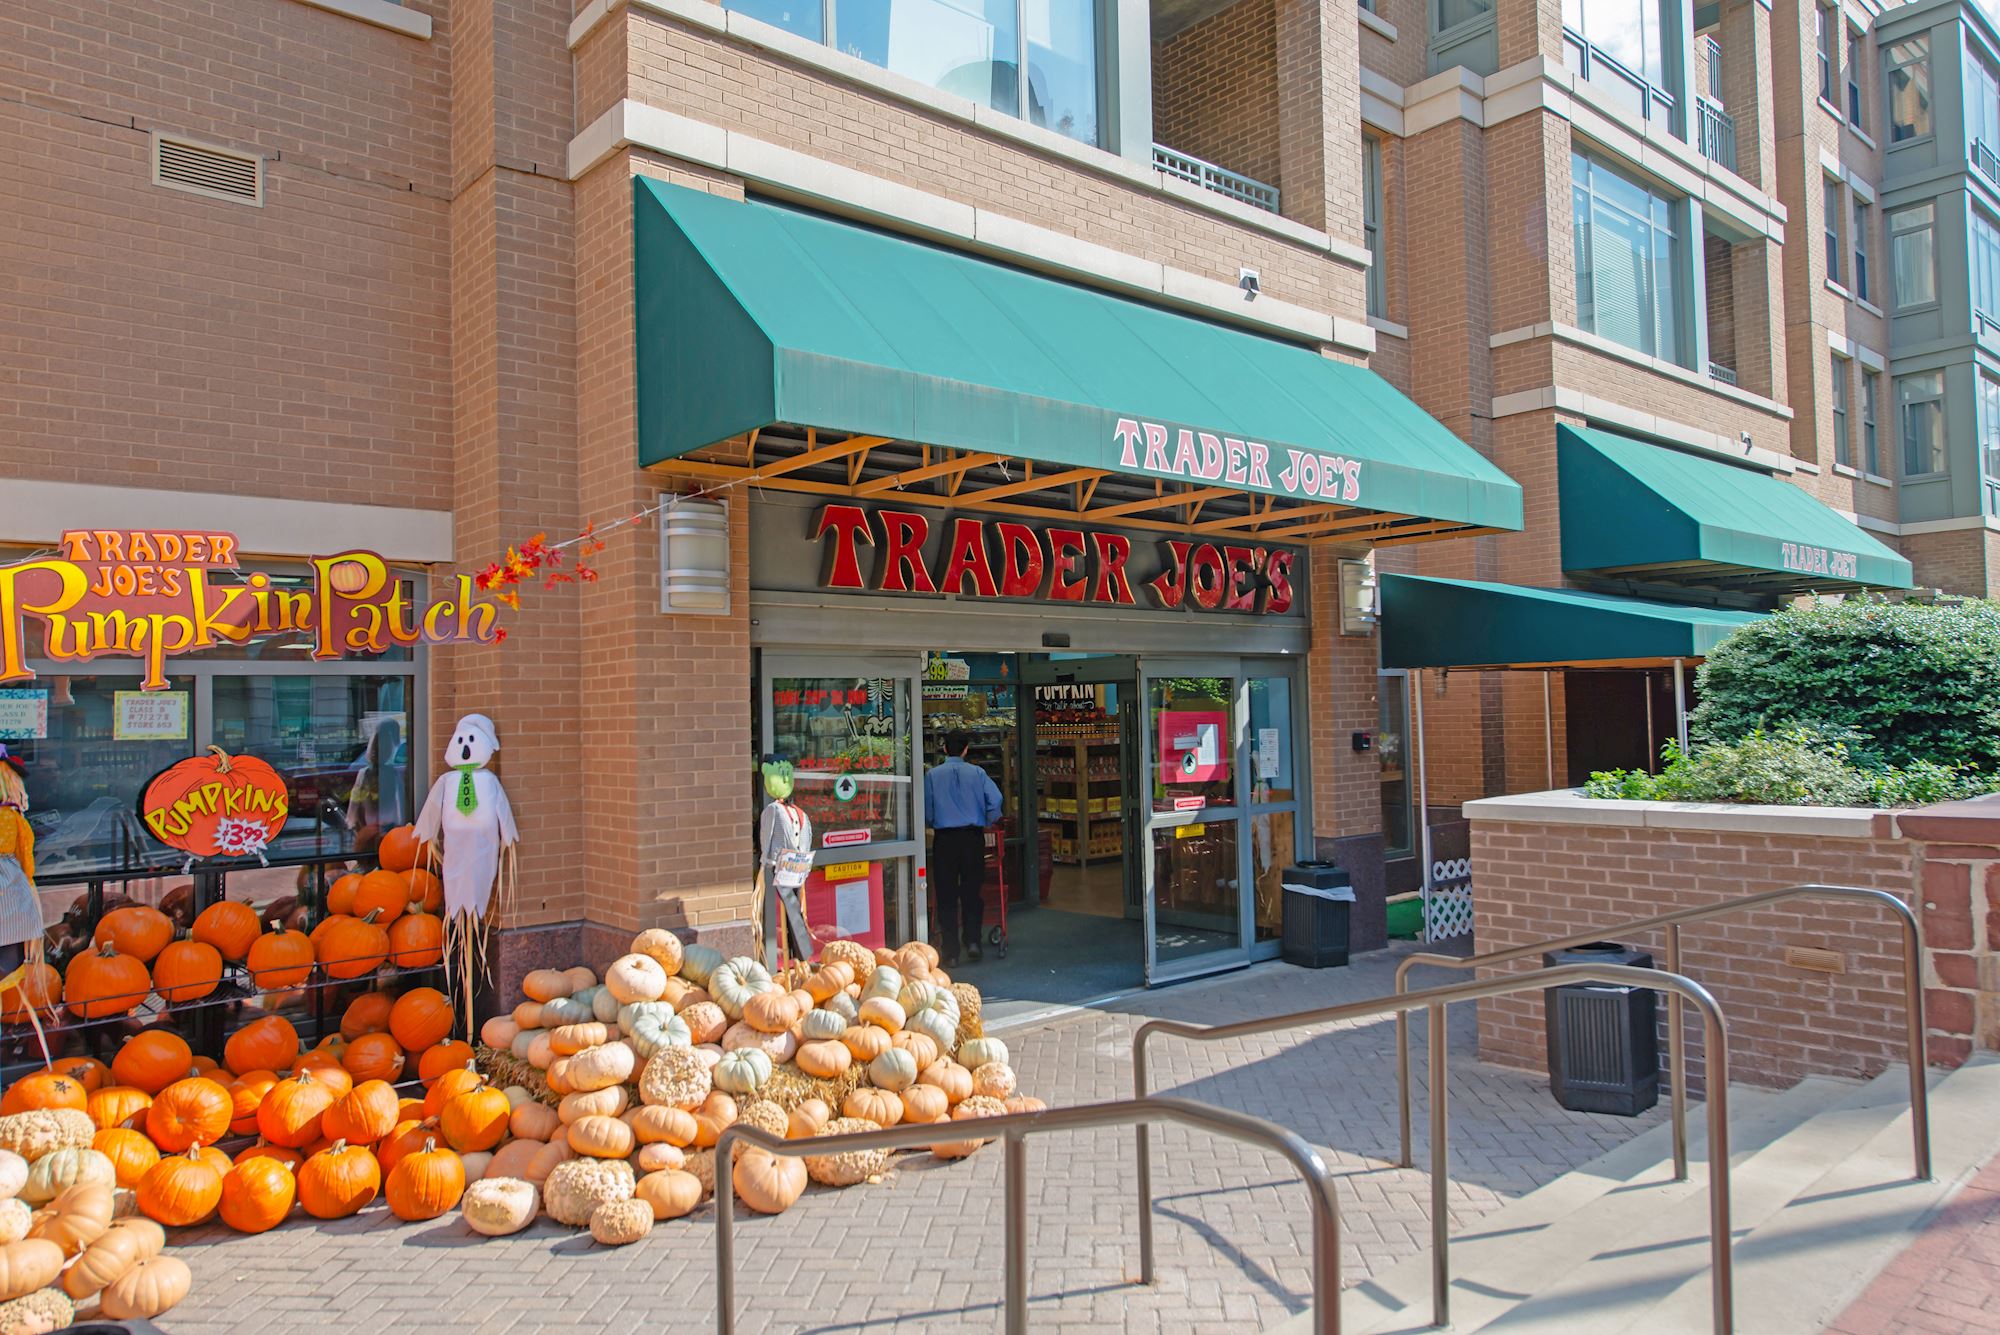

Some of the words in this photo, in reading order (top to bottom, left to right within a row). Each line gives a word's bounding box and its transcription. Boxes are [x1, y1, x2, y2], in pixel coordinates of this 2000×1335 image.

[1114, 418, 1272, 489] TRADER
[1278, 449, 1362, 501] JOE'S
[64, 531, 236, 564] TRADER
[811, 504, 1136, 604] TRADER
[1145, 540, 1295, 614] JOE'S
[1782, 543, 1829, 574] TRADER
[92, 566, 182, 597] JOE'S
[0, 560, 313, 689] Pumpkin
[315, 553, 497, 658] Patch
[1034, 684, 1095, 700] PUMPKIN
[463, 773, 471, 807] BOO
[144, 782, 288, 840] PUMPKINS
[833, 864, 863, 874] CAUTION
